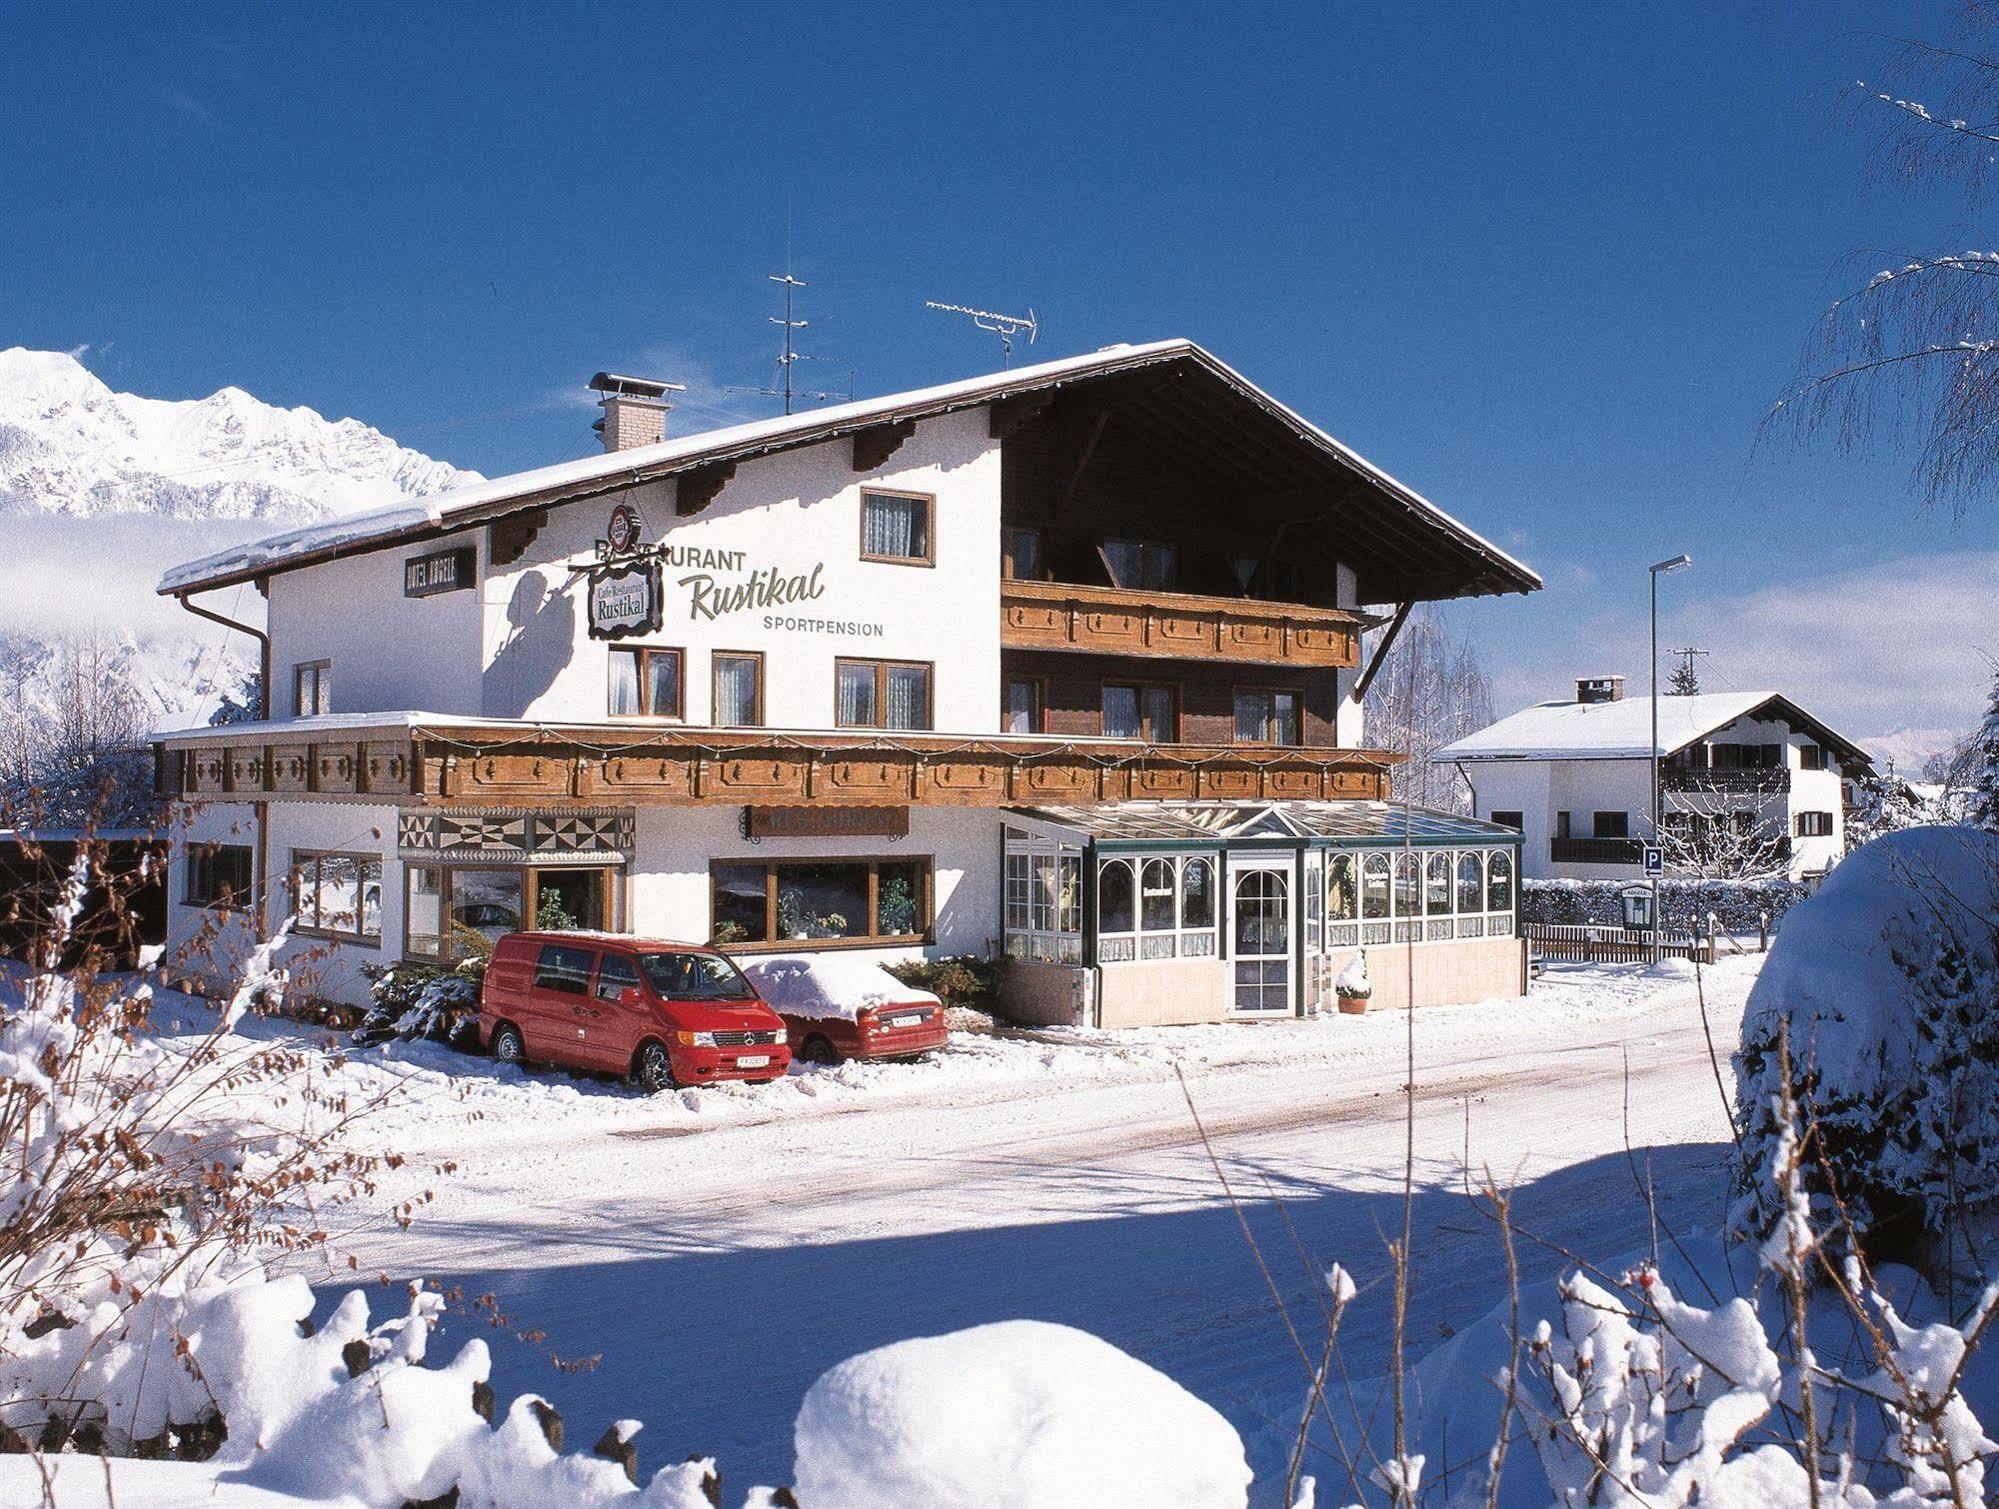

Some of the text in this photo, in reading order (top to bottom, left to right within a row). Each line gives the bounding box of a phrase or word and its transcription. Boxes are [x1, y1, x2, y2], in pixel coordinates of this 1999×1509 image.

[594, 539, 747, 572] RTURANT
[598, 592, 645, 620] Rustikal
[677, 562, 826, 622] Rustikal
[763, 615, 884, 637] SPORTPENSION
[1648, 851, 1659, 867] P
